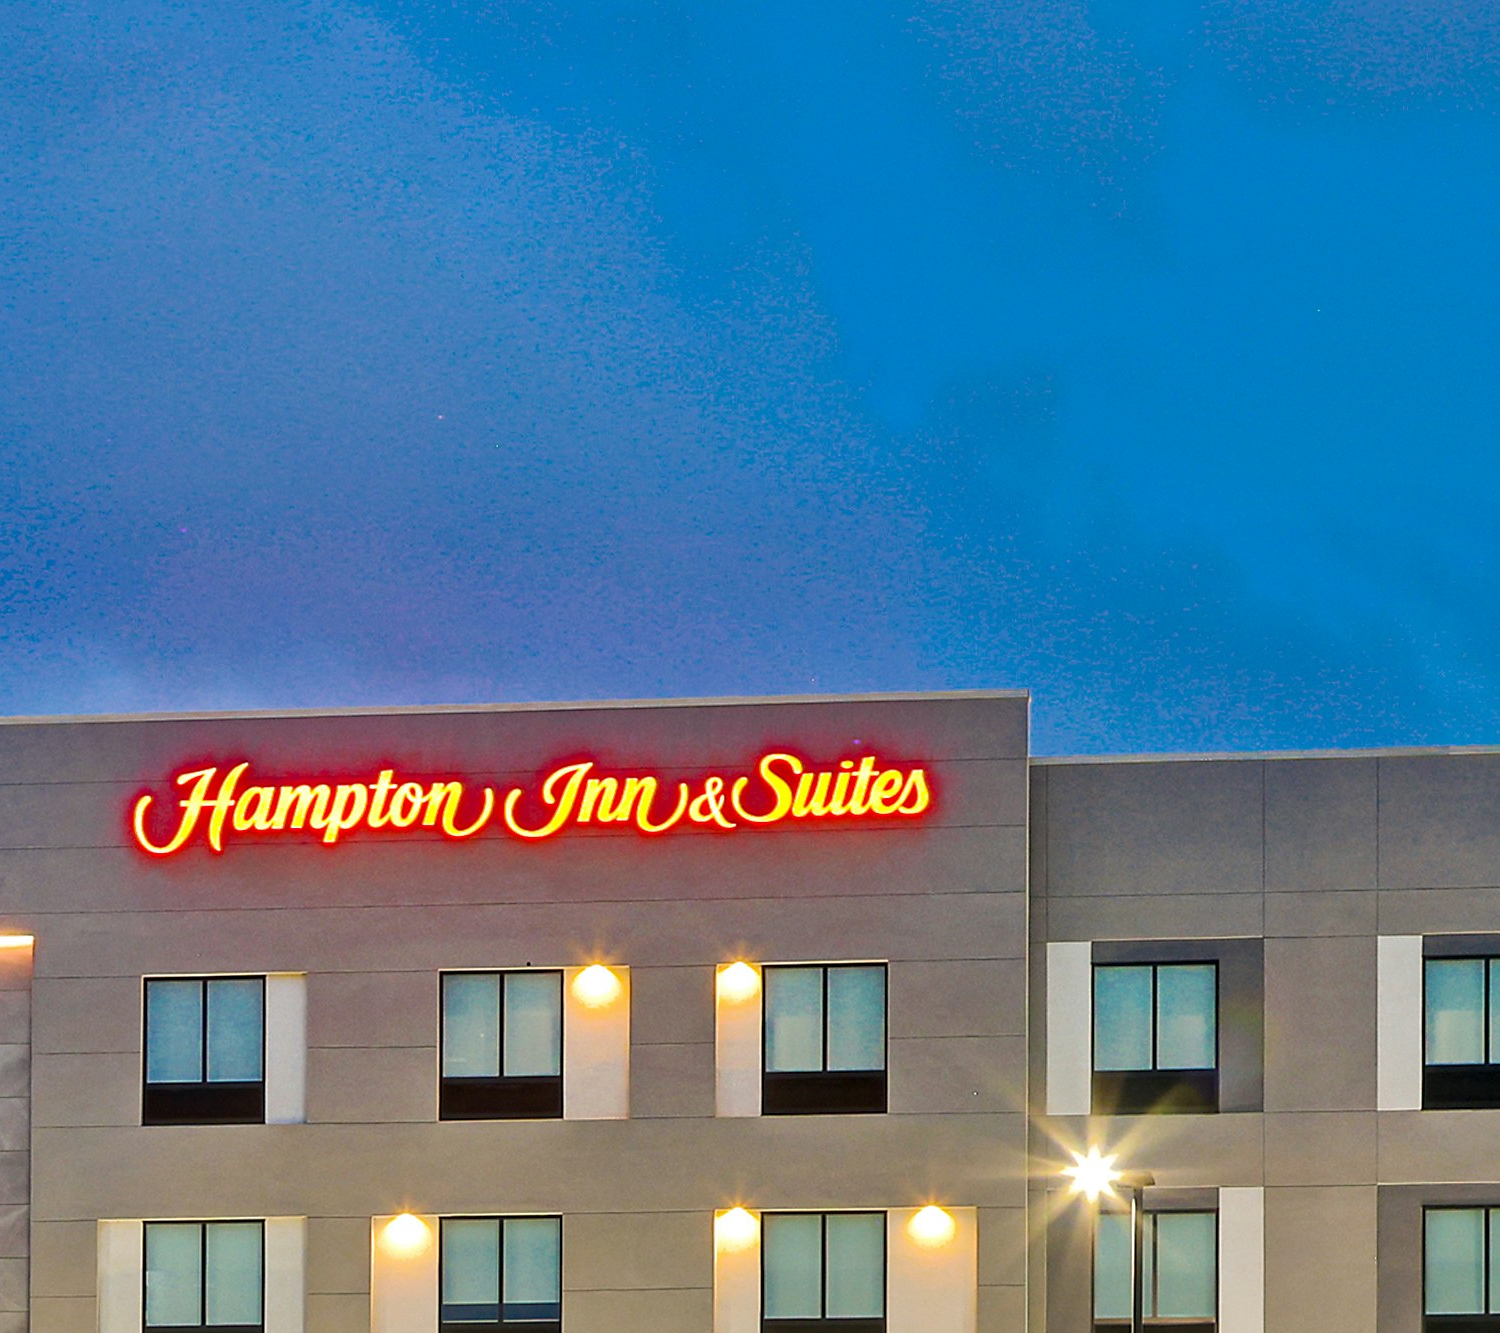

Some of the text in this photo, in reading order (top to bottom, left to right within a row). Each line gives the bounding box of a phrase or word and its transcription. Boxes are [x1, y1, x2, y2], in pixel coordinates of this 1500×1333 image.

[133, 752, 930, 855] Hampton Inn & Suites
